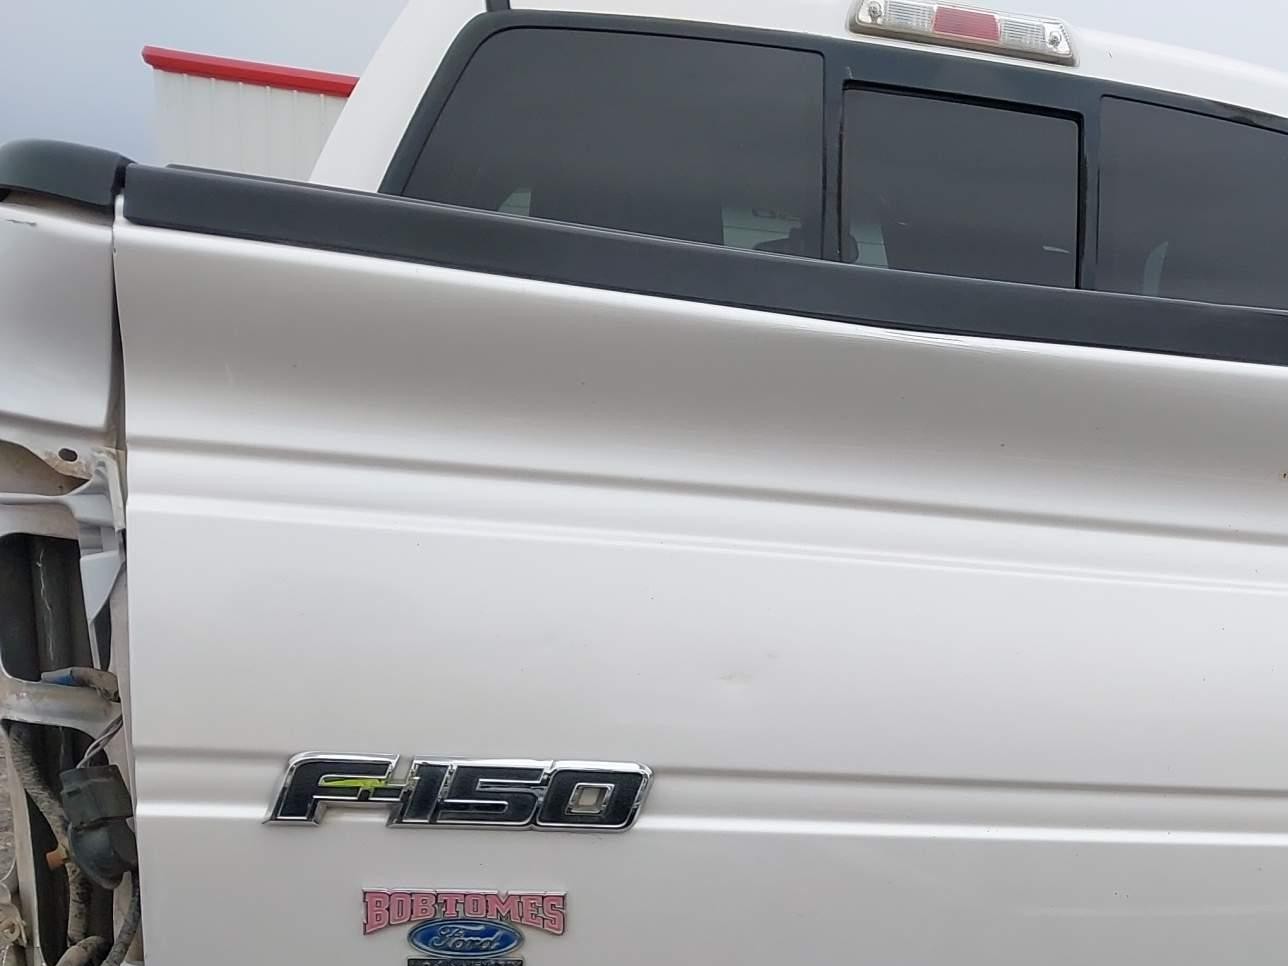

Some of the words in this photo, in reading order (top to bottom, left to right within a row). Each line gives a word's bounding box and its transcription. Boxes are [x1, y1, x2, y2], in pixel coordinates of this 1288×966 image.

[262, 751, 656, 832] F-150
[363, 888, 437, 935] BOB
[437, 889, 567, 936] TOMES
[429, 923, 500, 951] Ford
